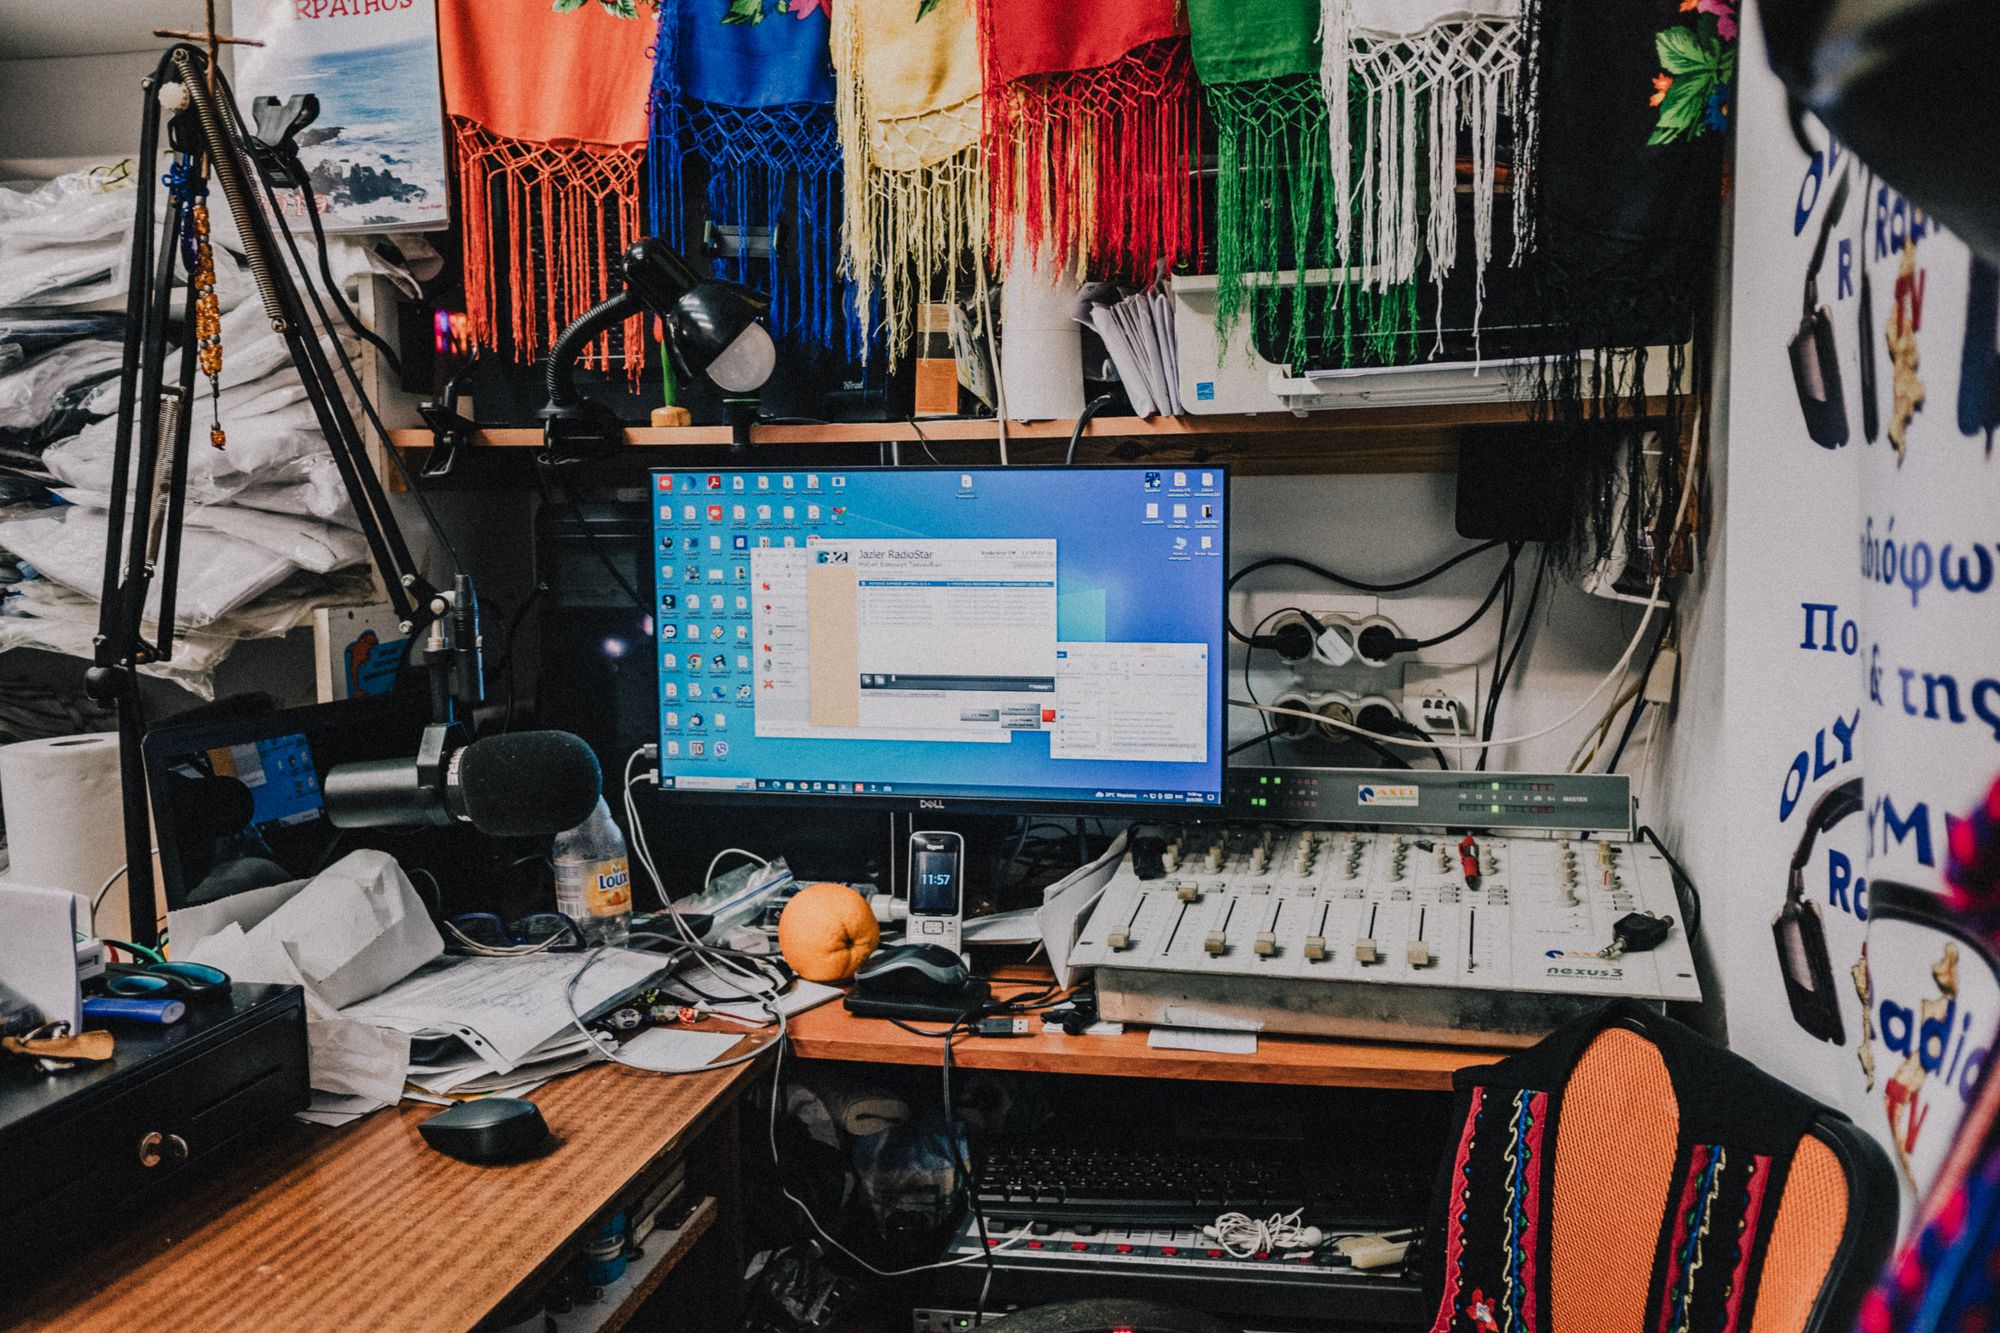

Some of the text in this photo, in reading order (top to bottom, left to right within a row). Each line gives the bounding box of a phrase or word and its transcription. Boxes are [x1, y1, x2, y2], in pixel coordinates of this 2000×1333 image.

[859, 549, 885, 559] Jazler
[888, 549, 933, 559] RadioStar
[920, 799, 945, 809] DELL
[921, 874, 951, 886] 11:57
[1547, 966, 1624, 978] nexus3
[1868, 978, 1988, 1103] adio
